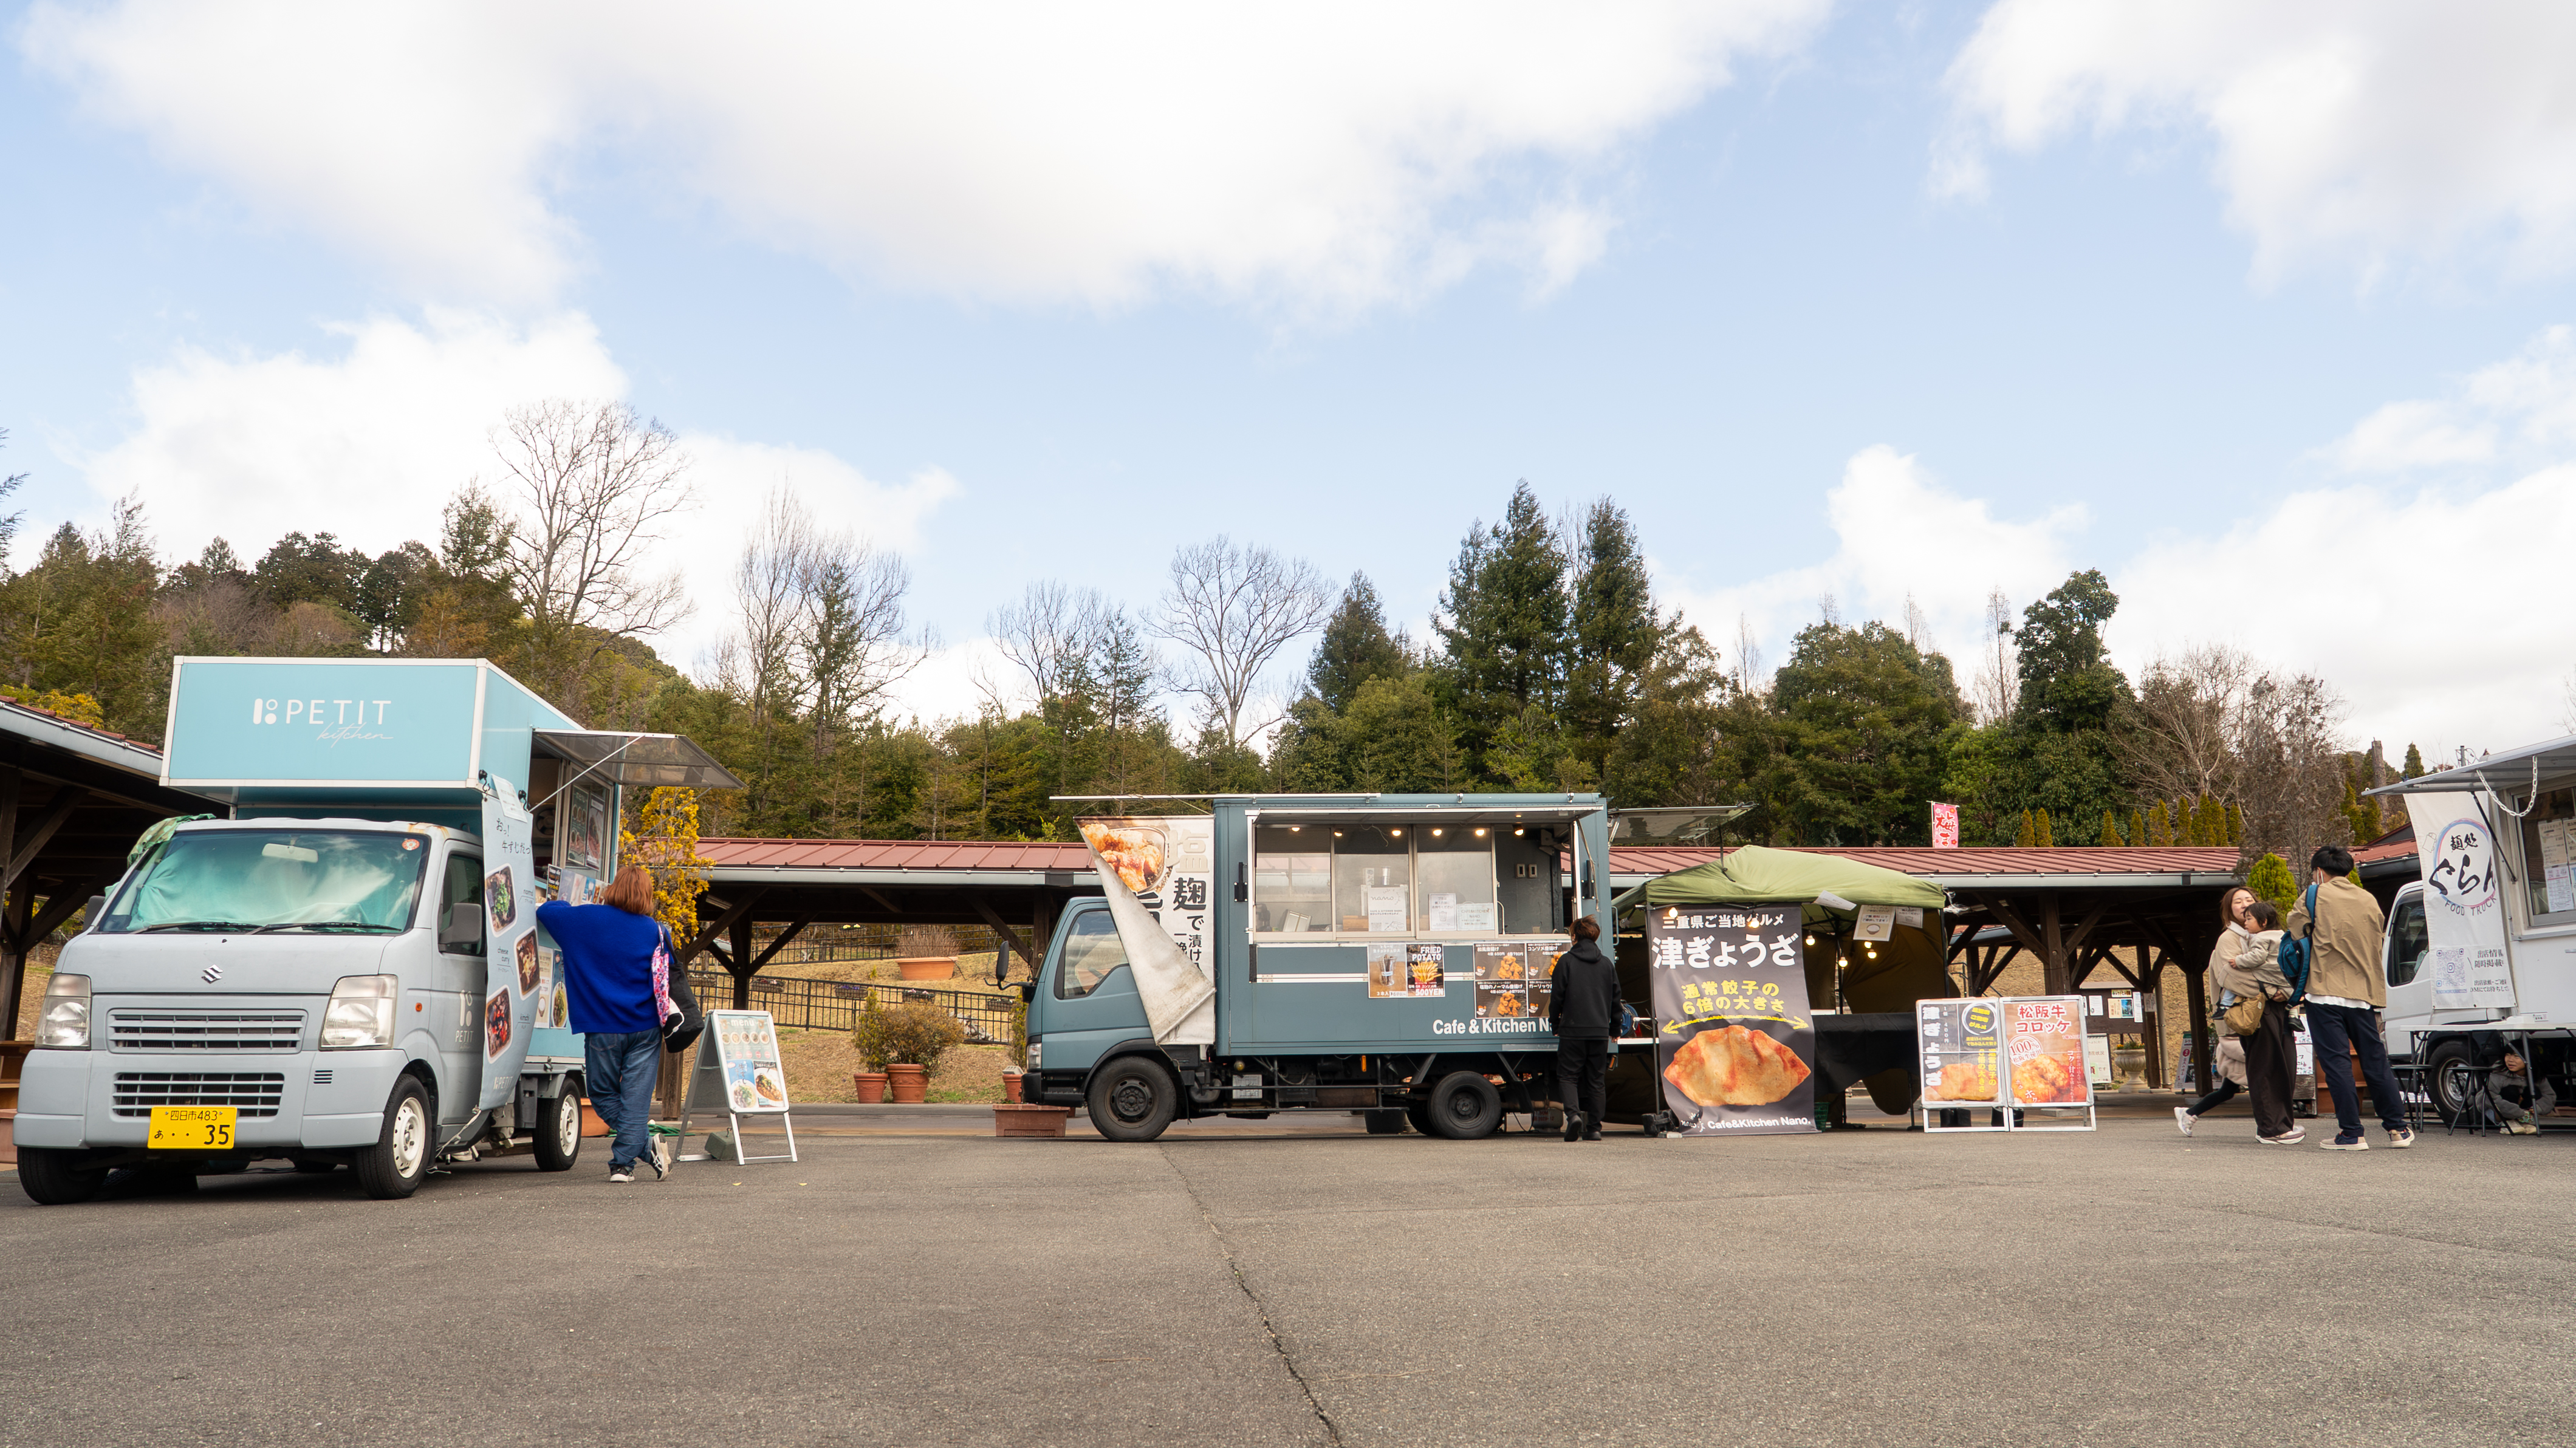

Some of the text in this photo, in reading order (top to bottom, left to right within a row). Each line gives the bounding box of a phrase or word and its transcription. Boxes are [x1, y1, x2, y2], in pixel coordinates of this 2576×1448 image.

[286, 699, 392, 725] PETIT
[316, 722, 394, 748] kitchen
[1166, 830, 1210, 931] 塩麹で
[2445, 895, 2496, 916] FOOD TRUCK
[1651, 932, 1799, 969] 津ぎょうざ
[1681, 980, 1780, 1000] 通常餃子の
[1682, 995, 1785, 1015] 6倍の大きさ
[2019, 1004, 2065, 1019] 松阪牛
[1433, 1019, 1465, 1034] Cafe
[1468, 1019, 1480, 1034] &
[1482, 1018, 1536, 1033] Kitchen
[2016, 1020, 2070, 1033] コロッケ
[455, 1030, 474, 1043] PETIT
[1922, 1006, 1942, 1086] 津ぎょうざ
[2010, 1040, 2040, 1056] 100%
[1707, 1118, 1778, 1129] Cafe&Kitchen
[1780, 1116, 1811, 1125] Nano.
[154, 1124, 230, 1146] あ 35
